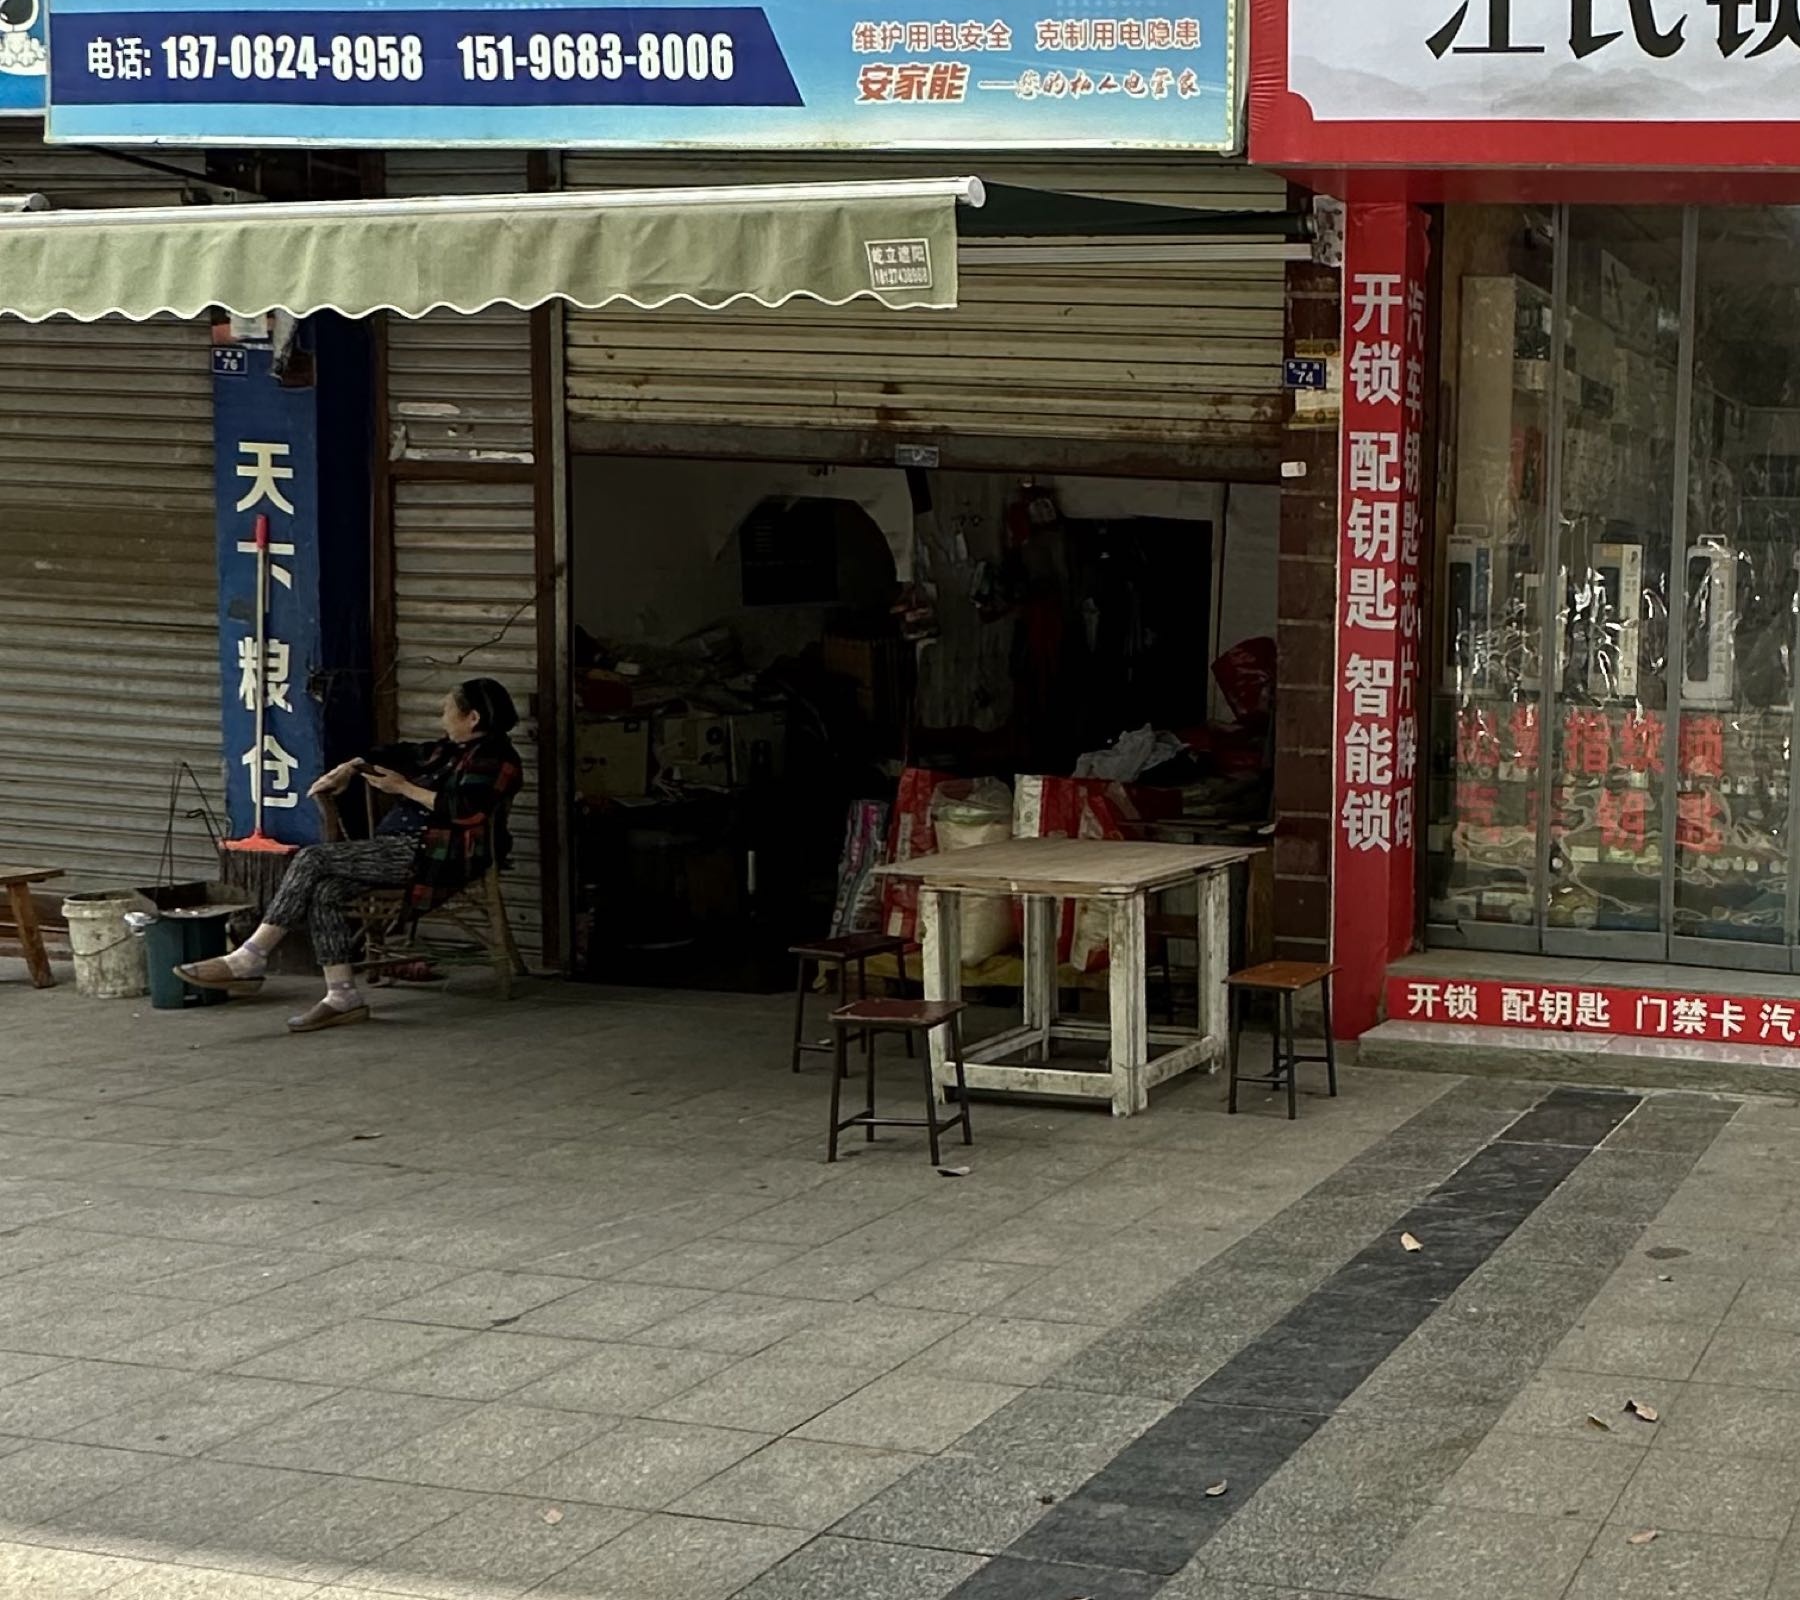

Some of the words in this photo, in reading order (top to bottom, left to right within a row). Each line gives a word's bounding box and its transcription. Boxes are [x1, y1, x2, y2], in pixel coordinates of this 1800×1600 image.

[87, 37, 152, 81] 电话:
[162, 35, 425, 82] 137-0824-8958
[457, 32, 735, 82] 151-9683-8006
[854, 20, 1012, 54] 维护用电安全
[1036, 17, 1202, 52] 克制用电隐患
[856, 63, 970, 104] 安家能
[221, 358, 239, 371] 76
[1350, 273, 1403, 406] 开锁
[1344, 431, 1401, 631] 配钥匙
[236, 441, 299, 809] 天下粮仓
[1341, 653, 1395, 853] 智能锁
[1407, 983, 1478, 1020] 开锁
[1500, 987, 1610, 1028] 配钥匙
[1636, 995, 1746, 1038] 门禁卡
